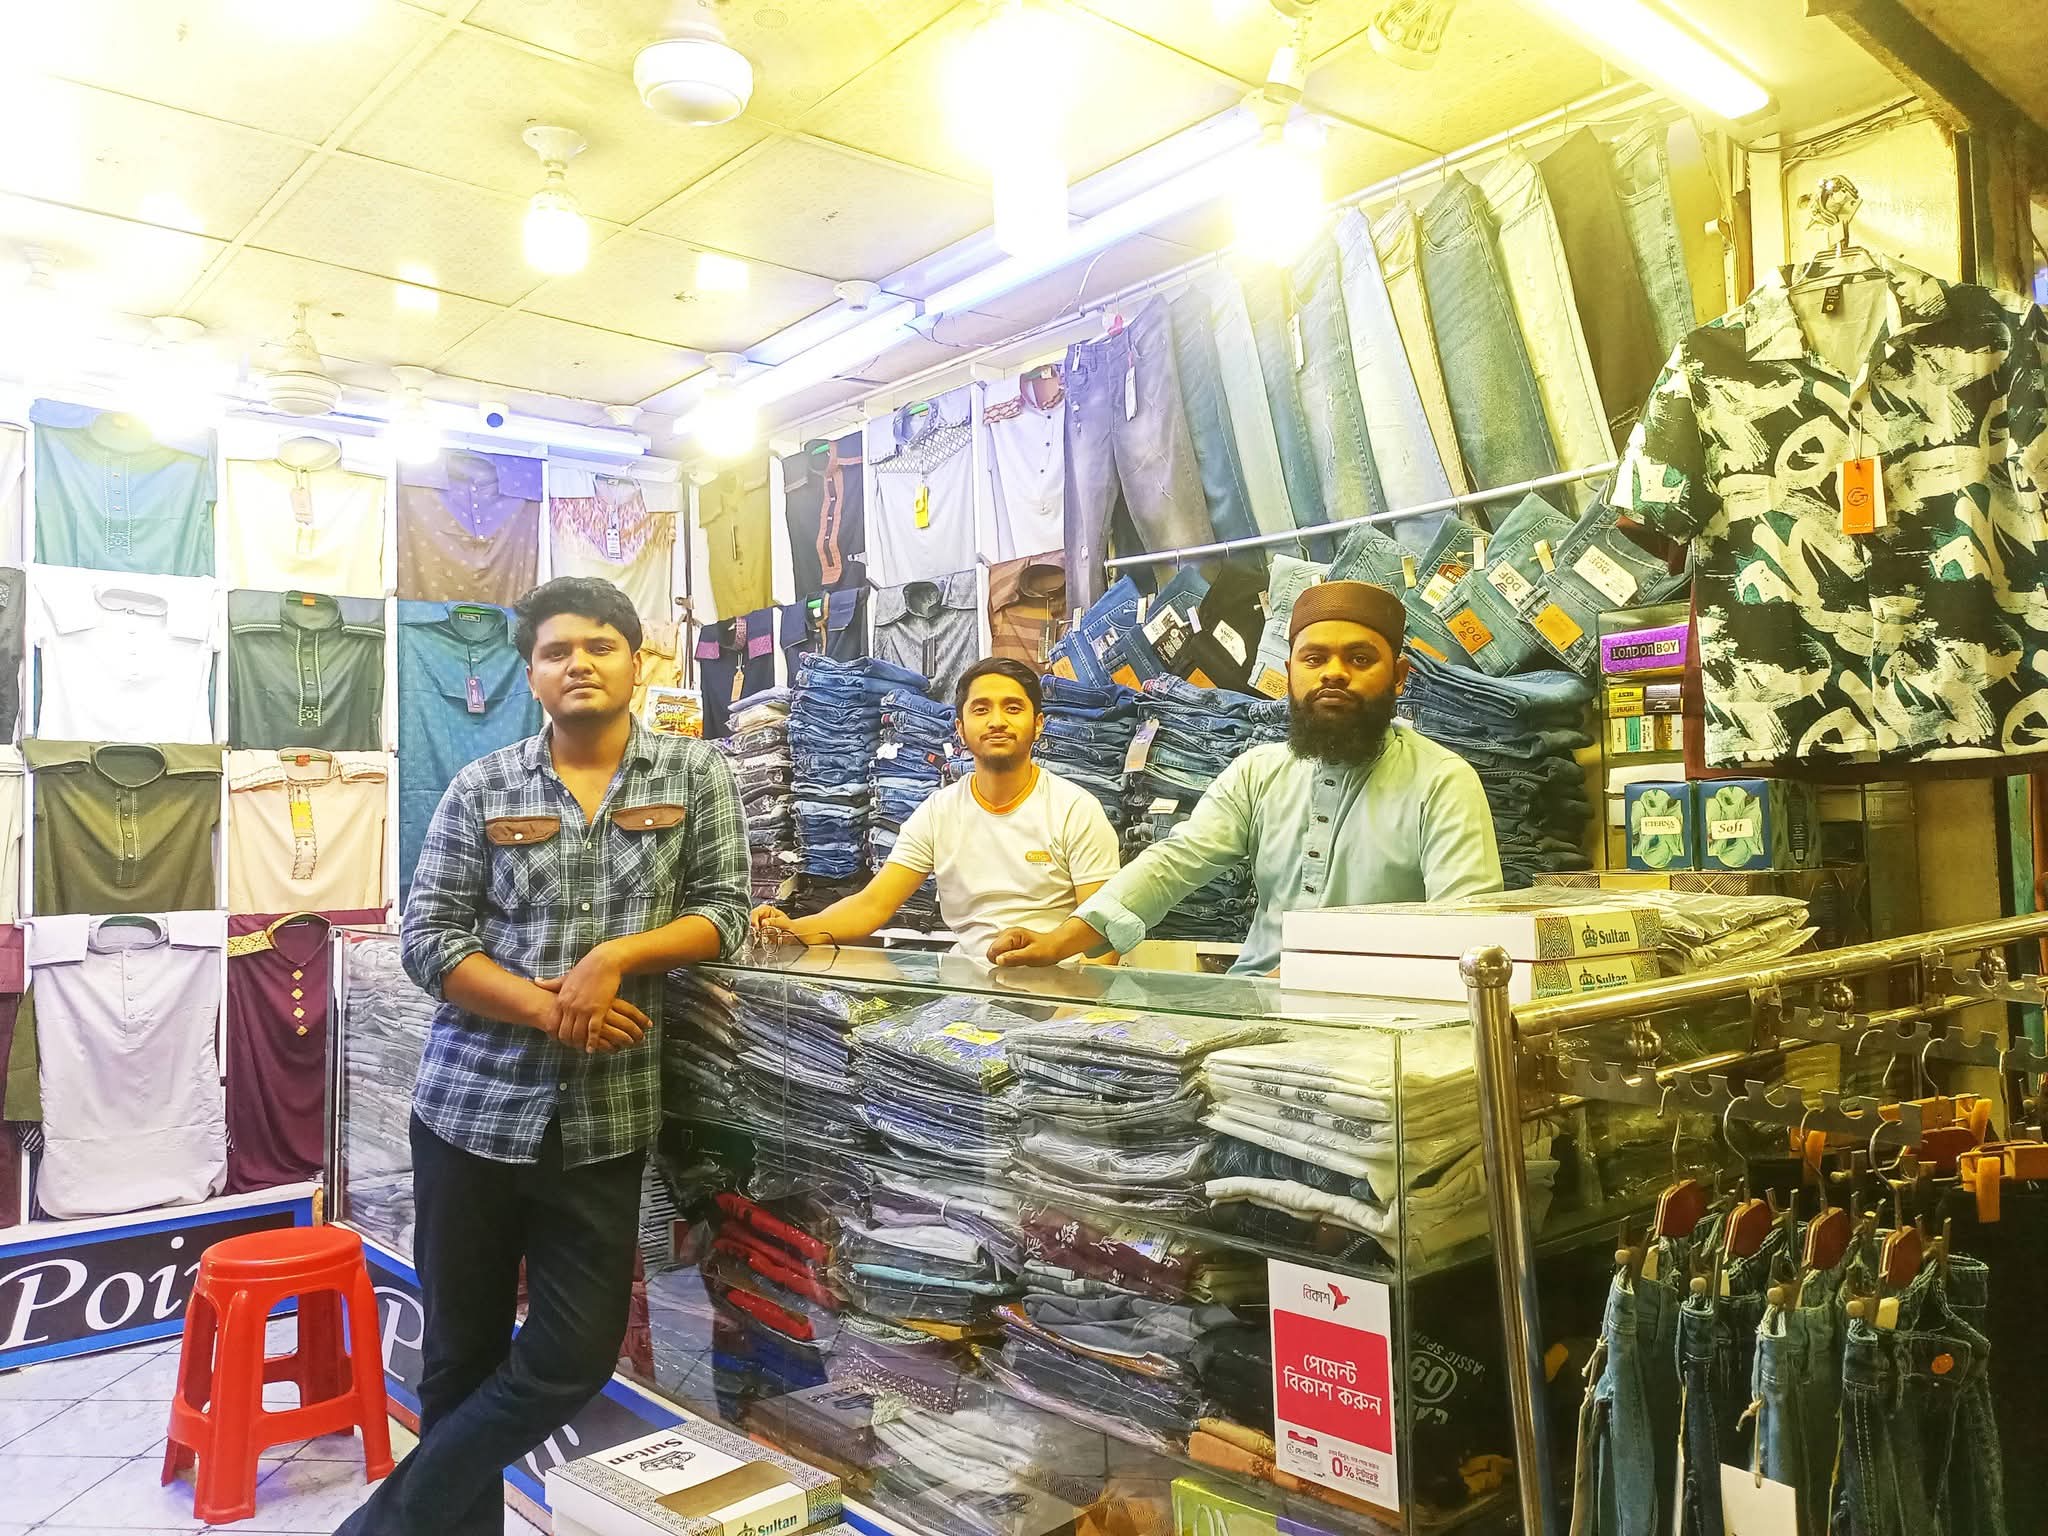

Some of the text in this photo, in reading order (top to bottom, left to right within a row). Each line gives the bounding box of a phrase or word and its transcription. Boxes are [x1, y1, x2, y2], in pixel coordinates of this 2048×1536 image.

[1717, 821, 1743, 834] Soft
[1598, 929, 1630, 945] Sultan
[0, 1236, 204, 1350] Poi
[1302, 1284, 1331, 1305] বিকাশ
[1303, 1352, 1358, 1386] পেমেন্ট
[1444, 1351, 1486, 1376] ASSIC
[1283, 1365, 1333, 1402] বিকাশ
[1337, 1385, 1382, 1416] করুন
[607, 1437, 683, 1466] Sultan
[757, 1512, 798, 1536] Sultan
